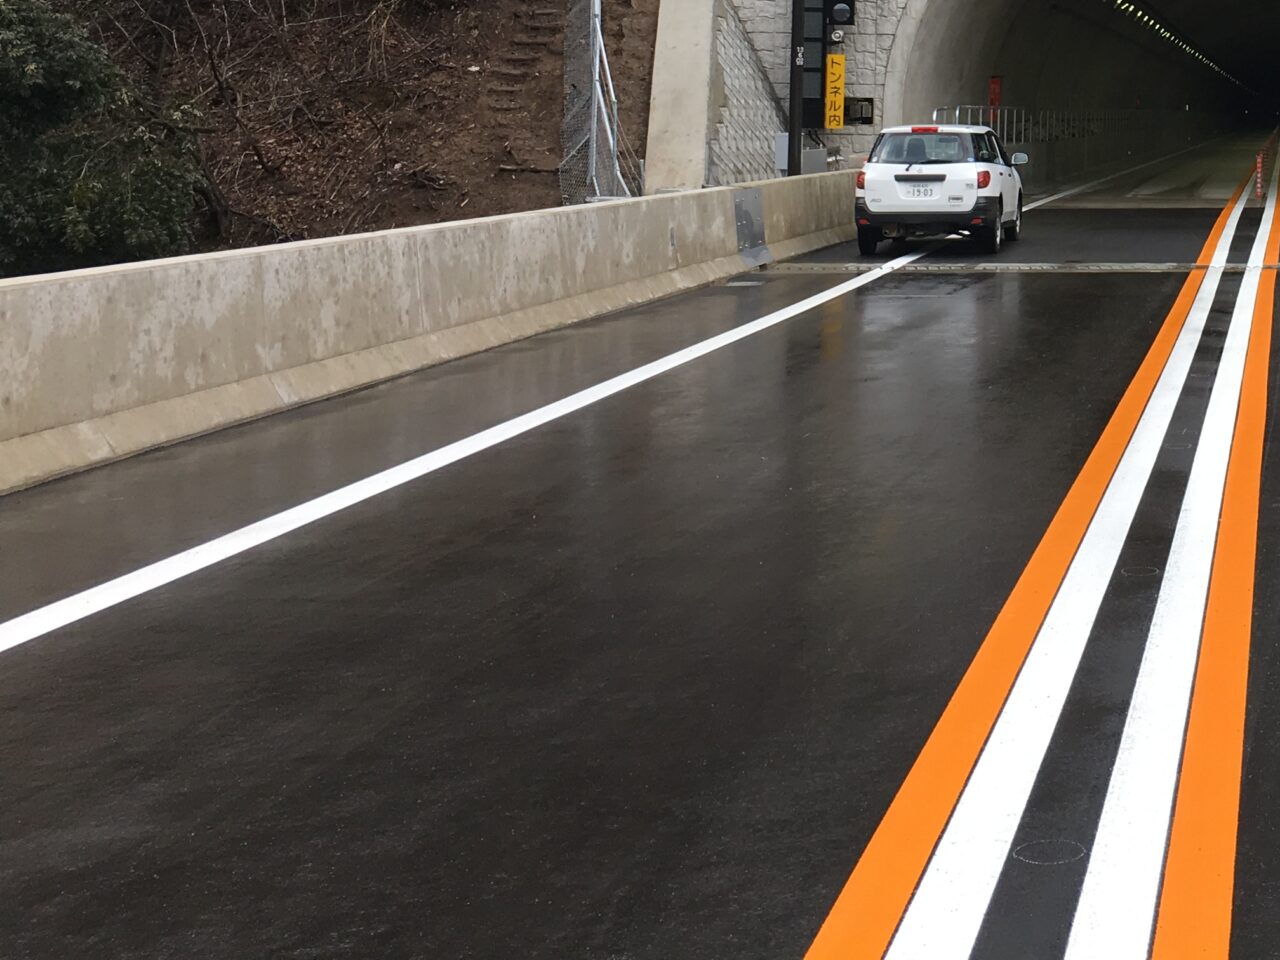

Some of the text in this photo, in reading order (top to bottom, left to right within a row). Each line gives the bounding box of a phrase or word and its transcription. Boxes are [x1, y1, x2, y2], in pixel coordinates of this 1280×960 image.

[829, 58, 841, 126] トンネル内
